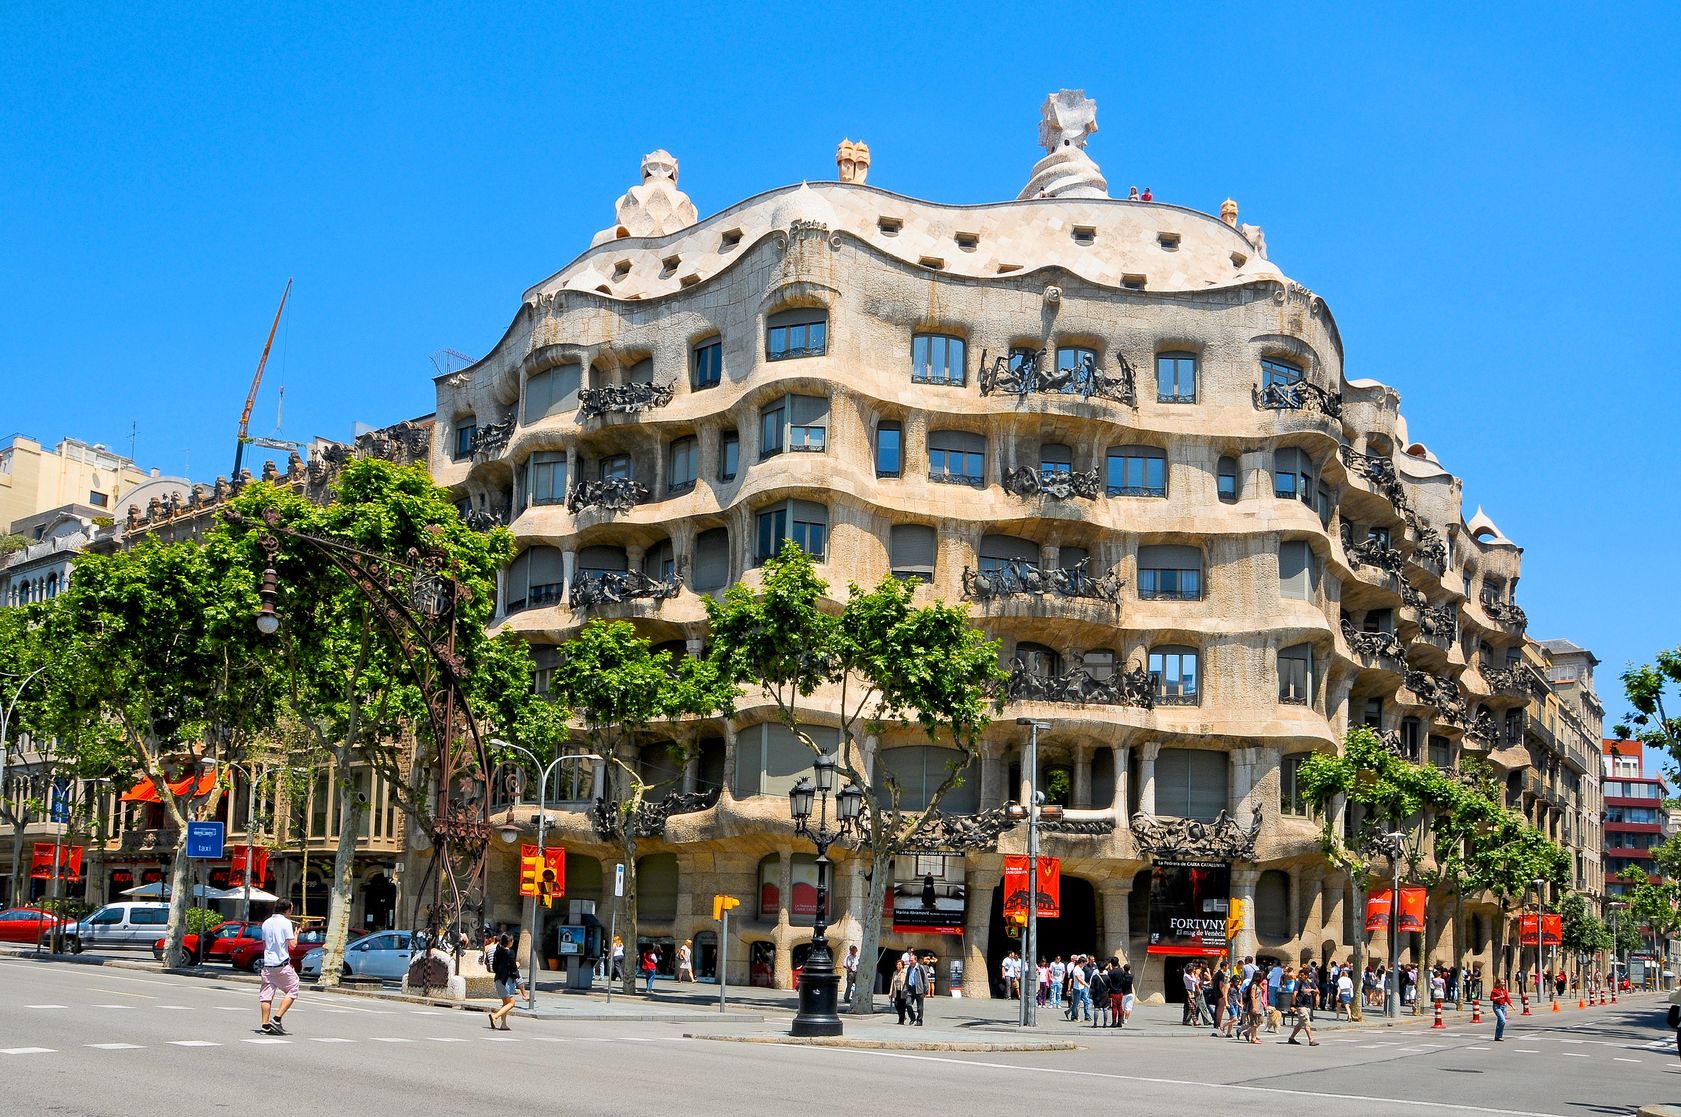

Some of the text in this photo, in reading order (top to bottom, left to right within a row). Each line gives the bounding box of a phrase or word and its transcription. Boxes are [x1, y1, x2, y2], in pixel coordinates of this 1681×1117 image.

[198, 844, 212, 852] taxi
[1170, 917, 1226, 930] FORTVNY
[1183, 930, 1196, 938] mag
